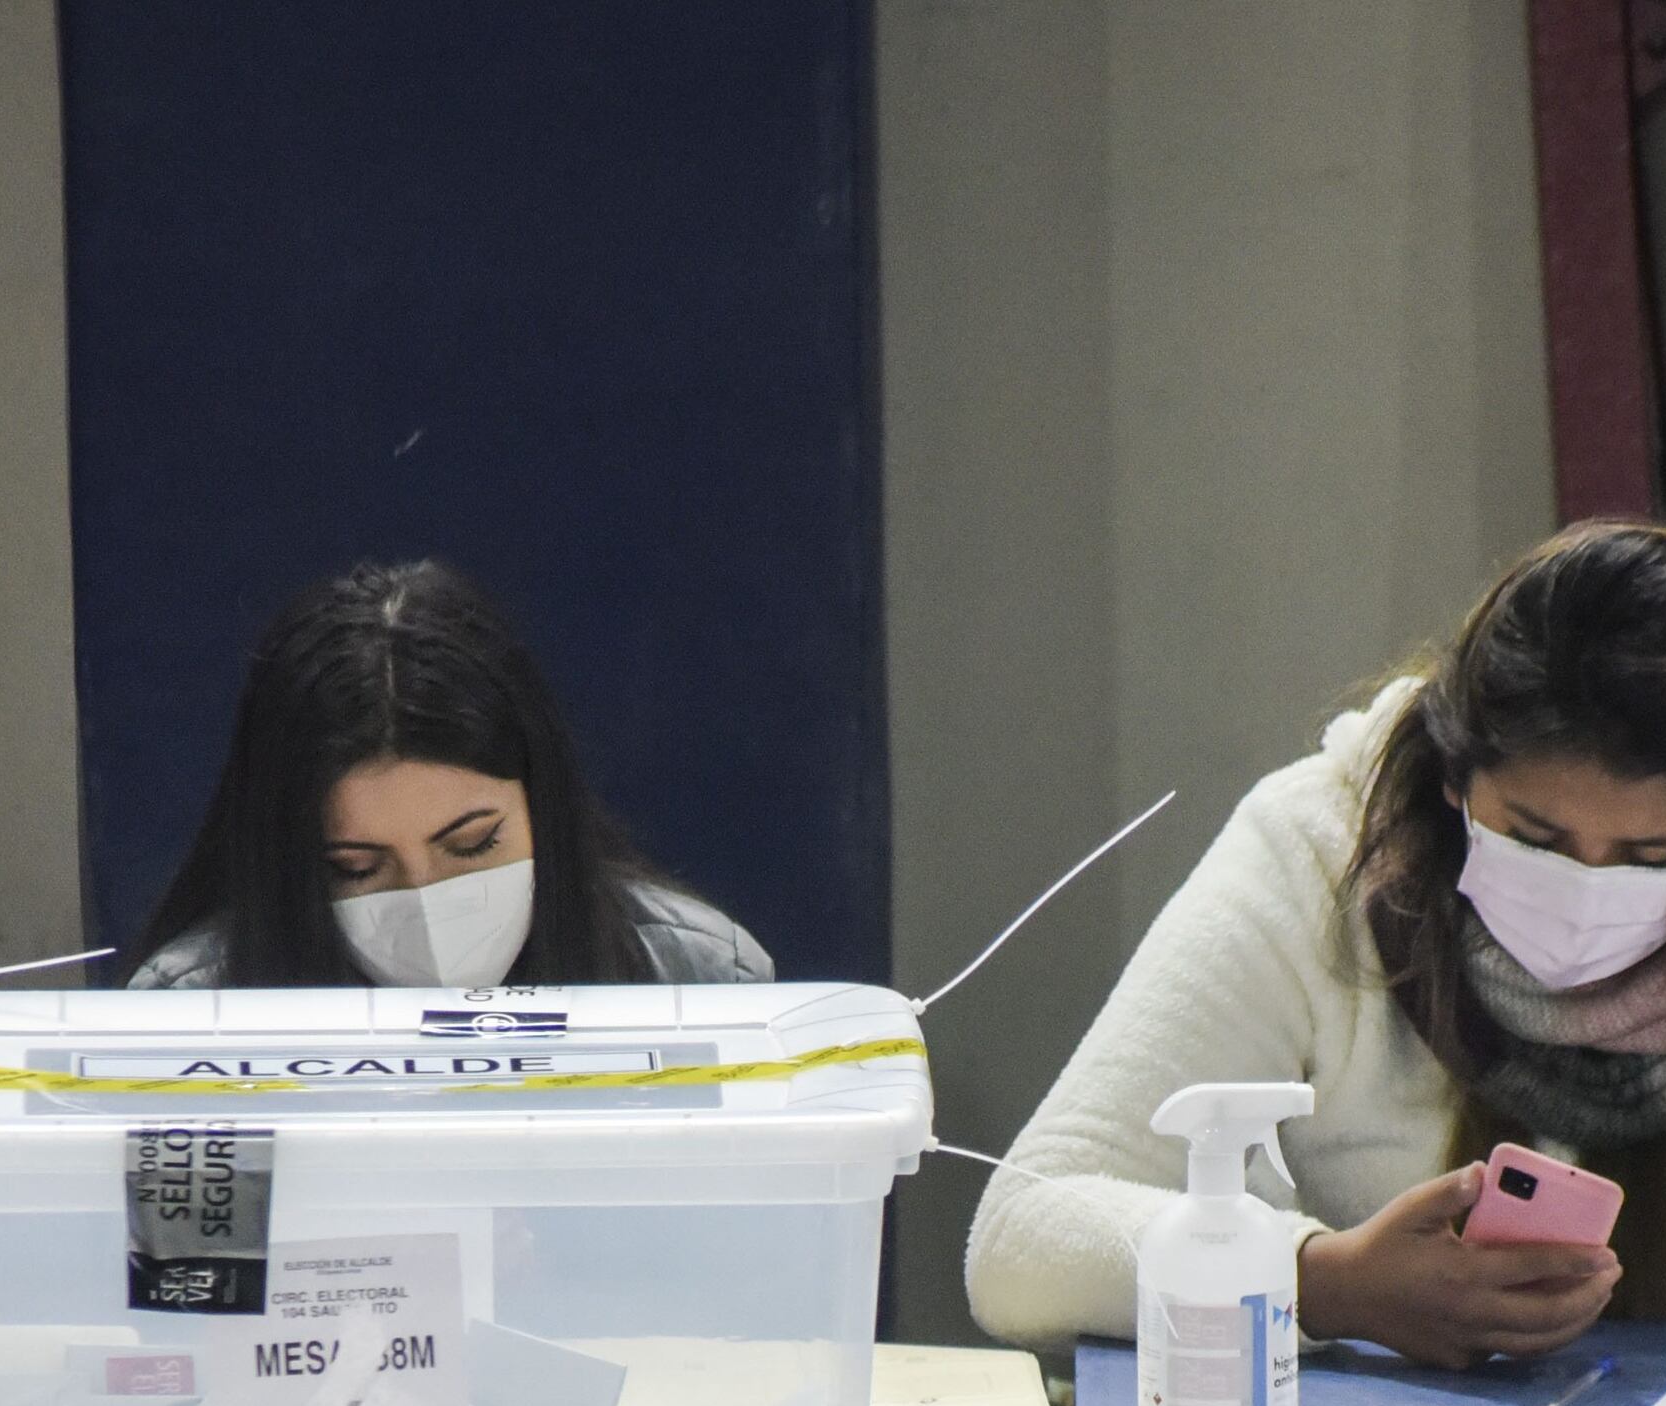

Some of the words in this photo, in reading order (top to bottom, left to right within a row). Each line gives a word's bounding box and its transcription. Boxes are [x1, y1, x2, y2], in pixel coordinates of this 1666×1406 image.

[178, 1056, 555, 1076] ALCALDE
[160, 1128, 194, 1221] SELLO
[317, 1286, 410, 1302] ELECTORAL
[255, 1340, 340, 1377] MES
